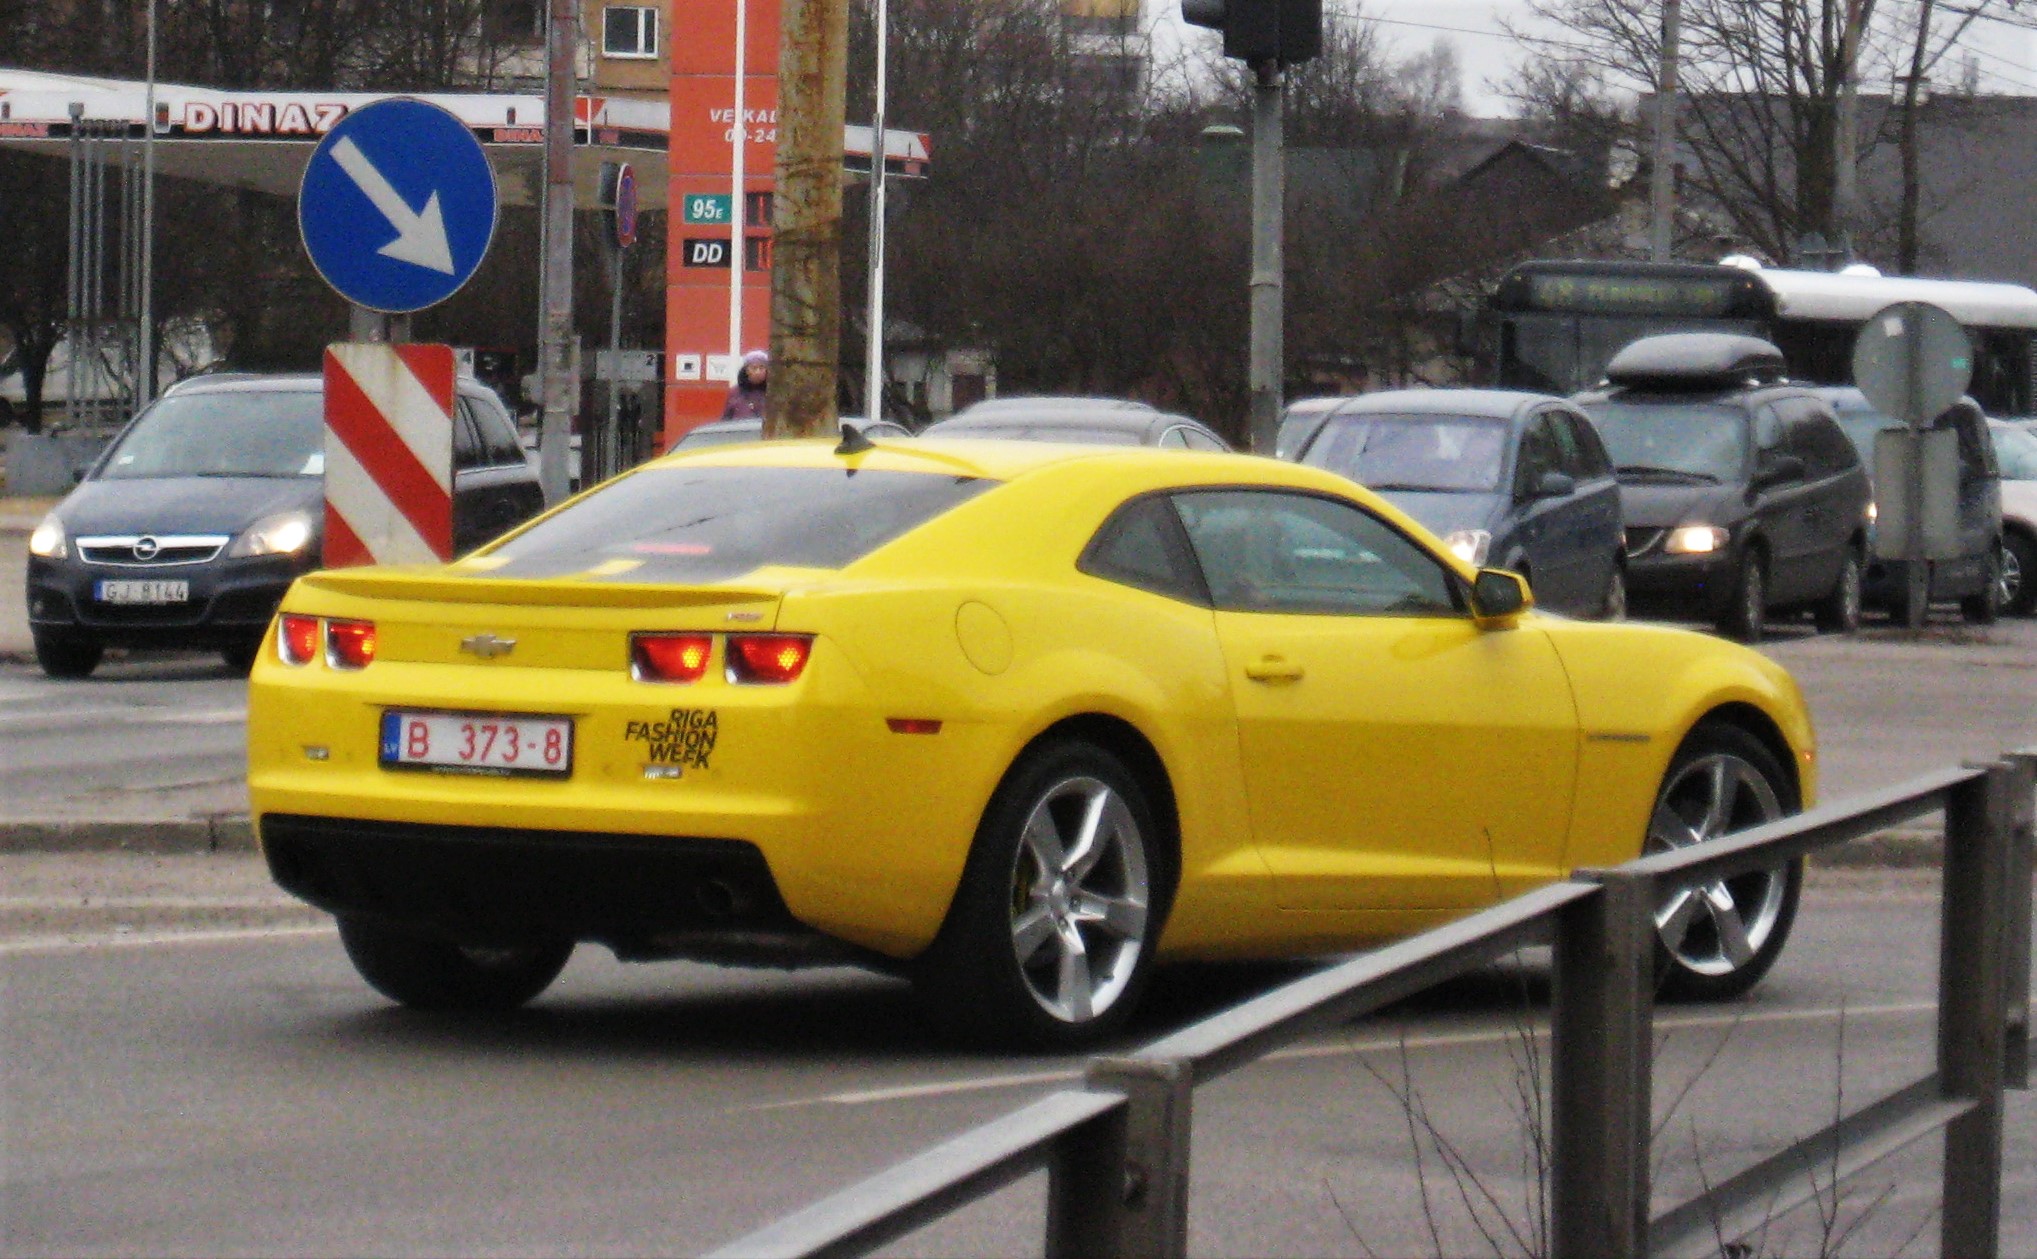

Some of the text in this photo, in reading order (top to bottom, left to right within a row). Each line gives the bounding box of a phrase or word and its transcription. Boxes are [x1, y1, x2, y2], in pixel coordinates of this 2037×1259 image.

[184, 102, 348, 132] DINAZ
[710, 108, 776, 123] VEKAL
[692, 243, 723, 264] DD
[670, 709, 718, 730] RIGA
[408, 721, 562, 764] B 373-8
[625, 721, 718, 750] FASHION
[649, 743, 710, 770] WEEK
